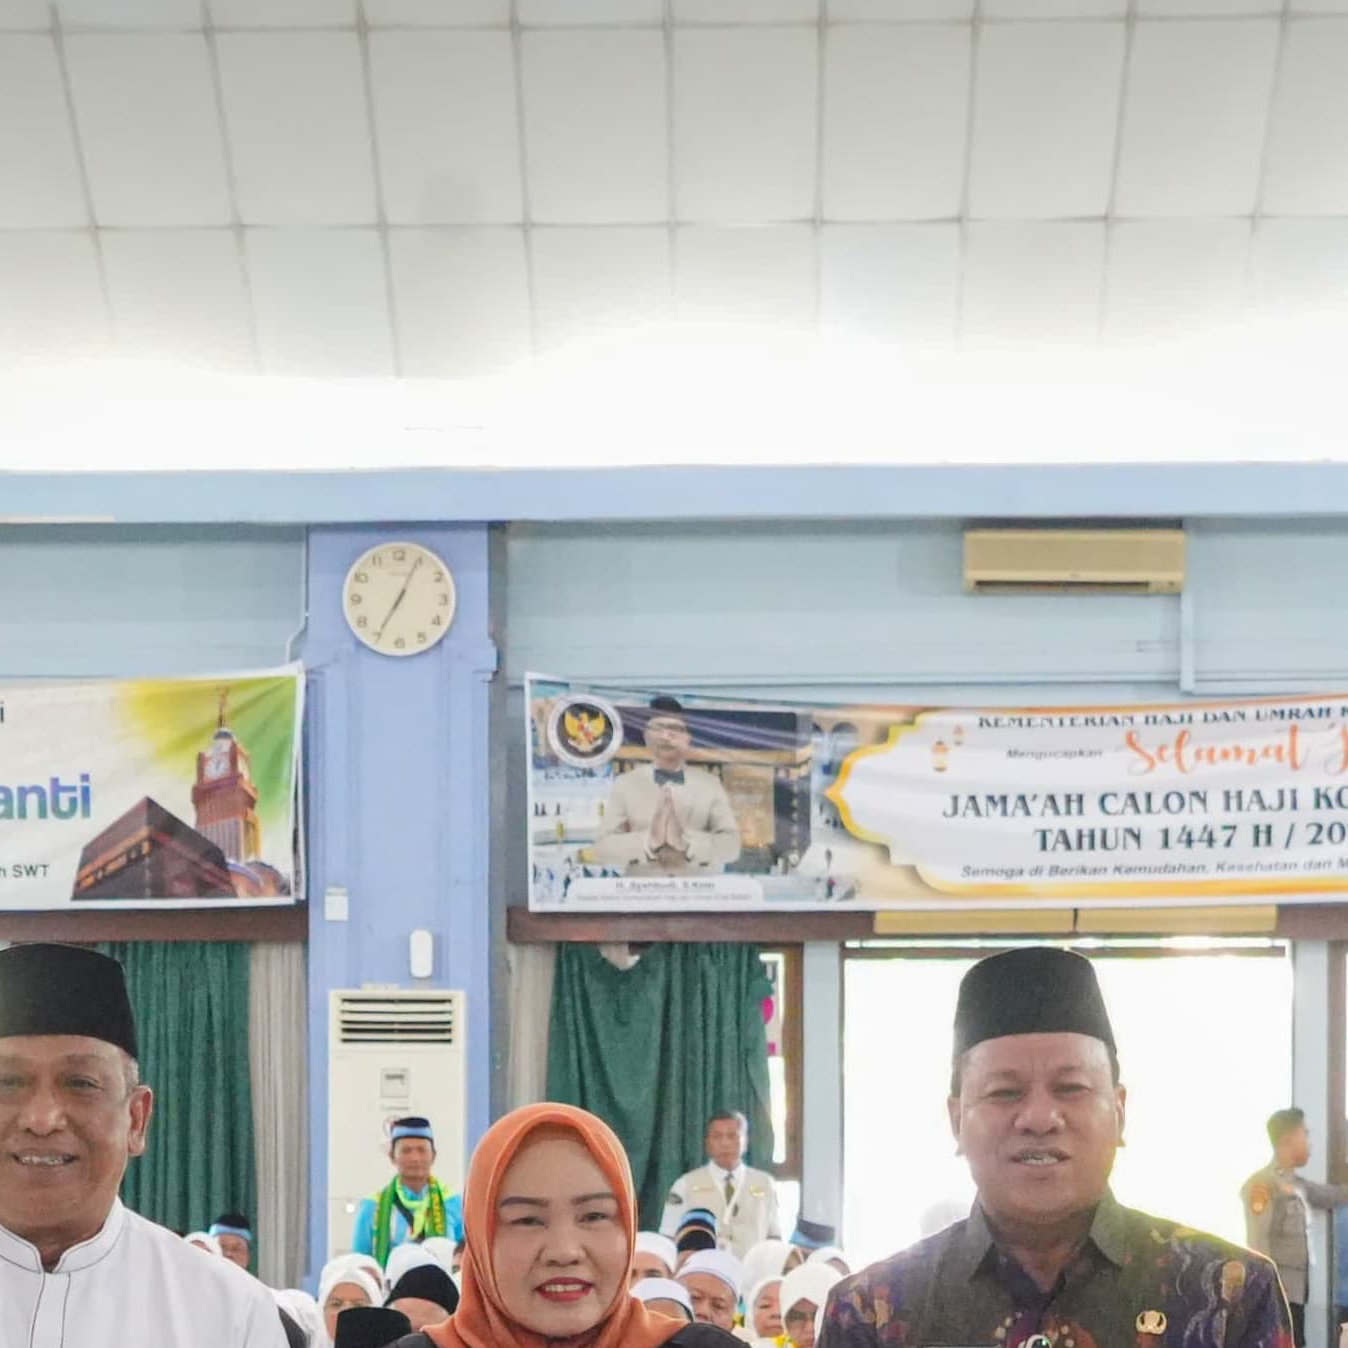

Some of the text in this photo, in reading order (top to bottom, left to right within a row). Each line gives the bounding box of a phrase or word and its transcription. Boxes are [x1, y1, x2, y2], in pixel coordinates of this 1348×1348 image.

[1203, 709, 1246, 724] DAN
[1255, 706, 1333, 722] UMRAH
[1125, 721, 1306, 775] Selamat
[942, 792, 1085, 818] JAMA'AH
[1097, 790, 1209, 816] CALON
[1222, 788, 1299, 814] HAJI
[1033, 827, 1143, 851] TAHUN
[1158, 824, 1238, 850] 1447
[1252, 823, 1273, 848] H
[1284, 822, 1296, 849] /
[12, 863, 50, 878] SWT
[961, 864, 1024, 880] Semoga
[1029, 864, 1044, 877] di
[1048, 864, 1109, 876] Berikan
[1215, 859, 1298, 873] Kesehatan
[1303, 857, 1333, 871] dan
